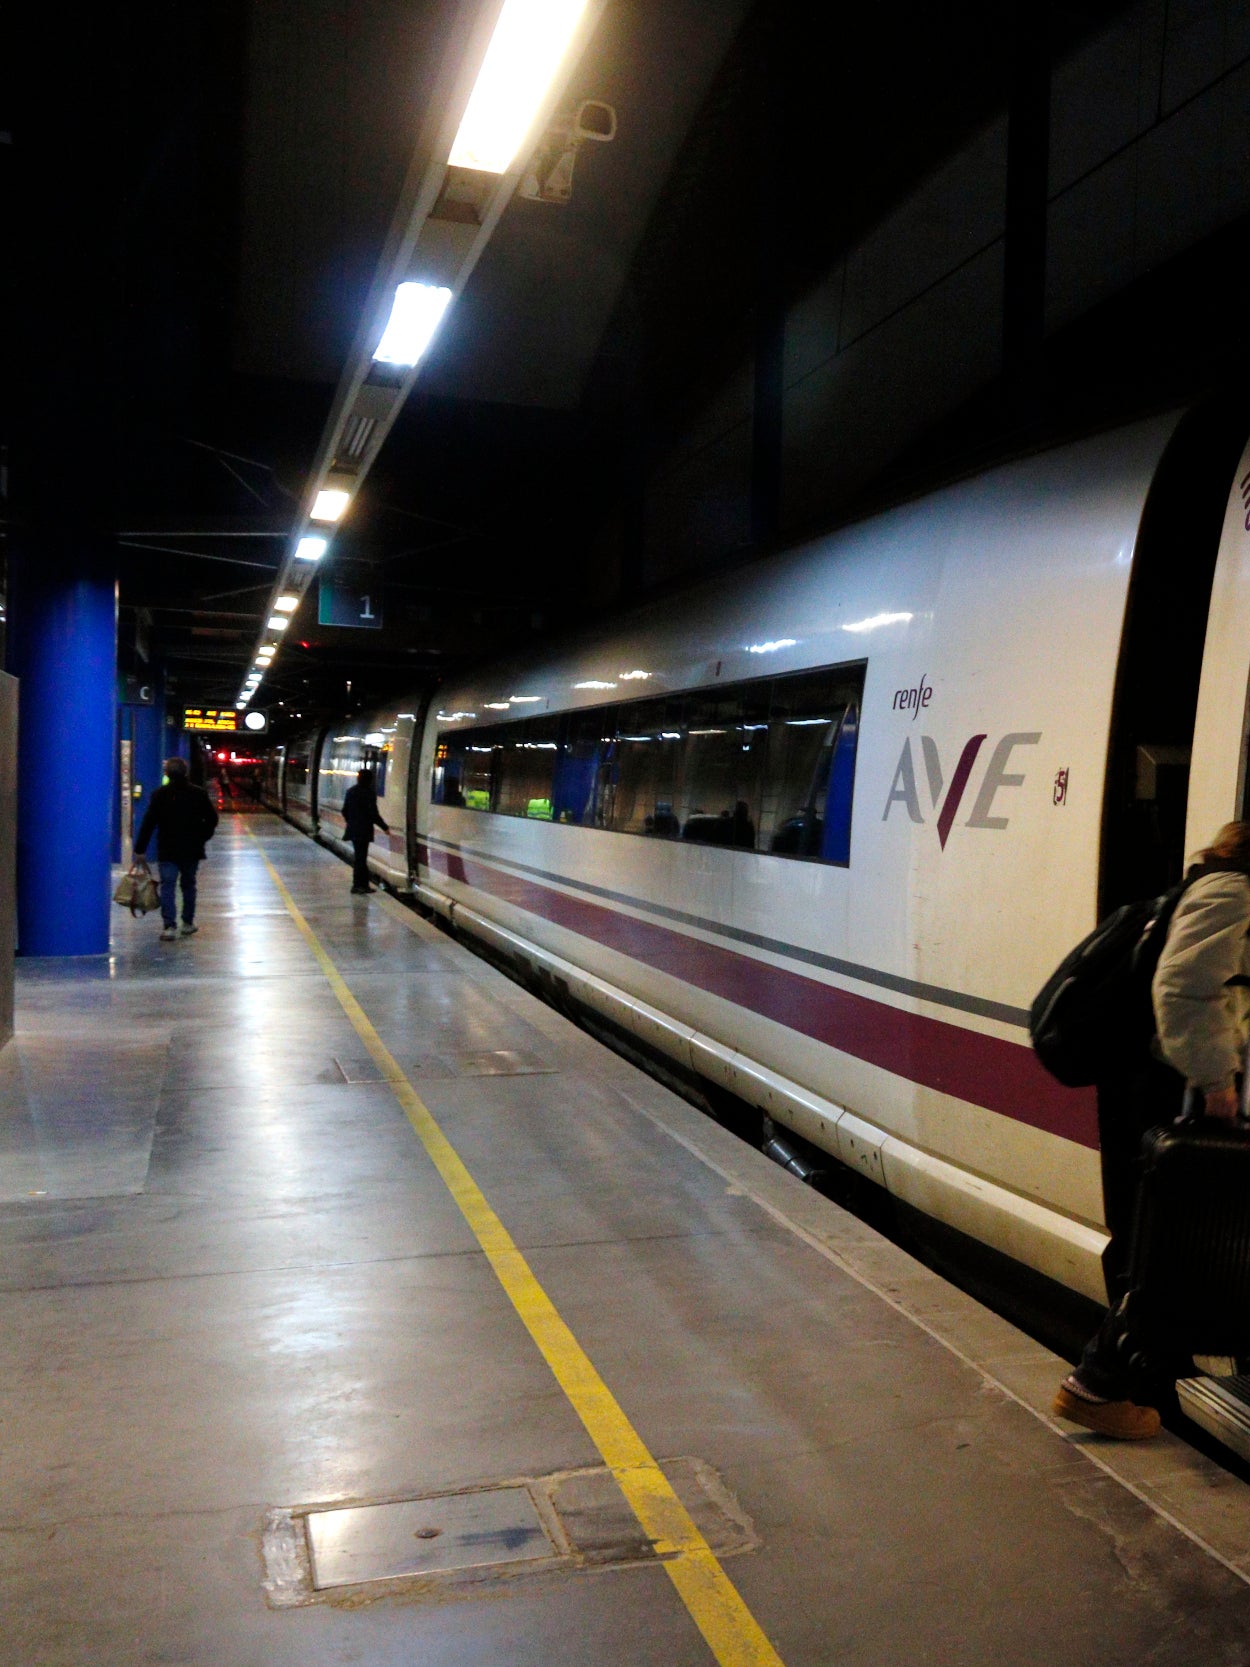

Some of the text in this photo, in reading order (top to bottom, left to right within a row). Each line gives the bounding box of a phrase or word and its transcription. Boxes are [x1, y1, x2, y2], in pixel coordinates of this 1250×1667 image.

[360, 596, 375, 619] 1
[140, 686, 149, 700] C
[892, 673, 933, 721] renfe
[881, 731, 1043, 853] AVE
